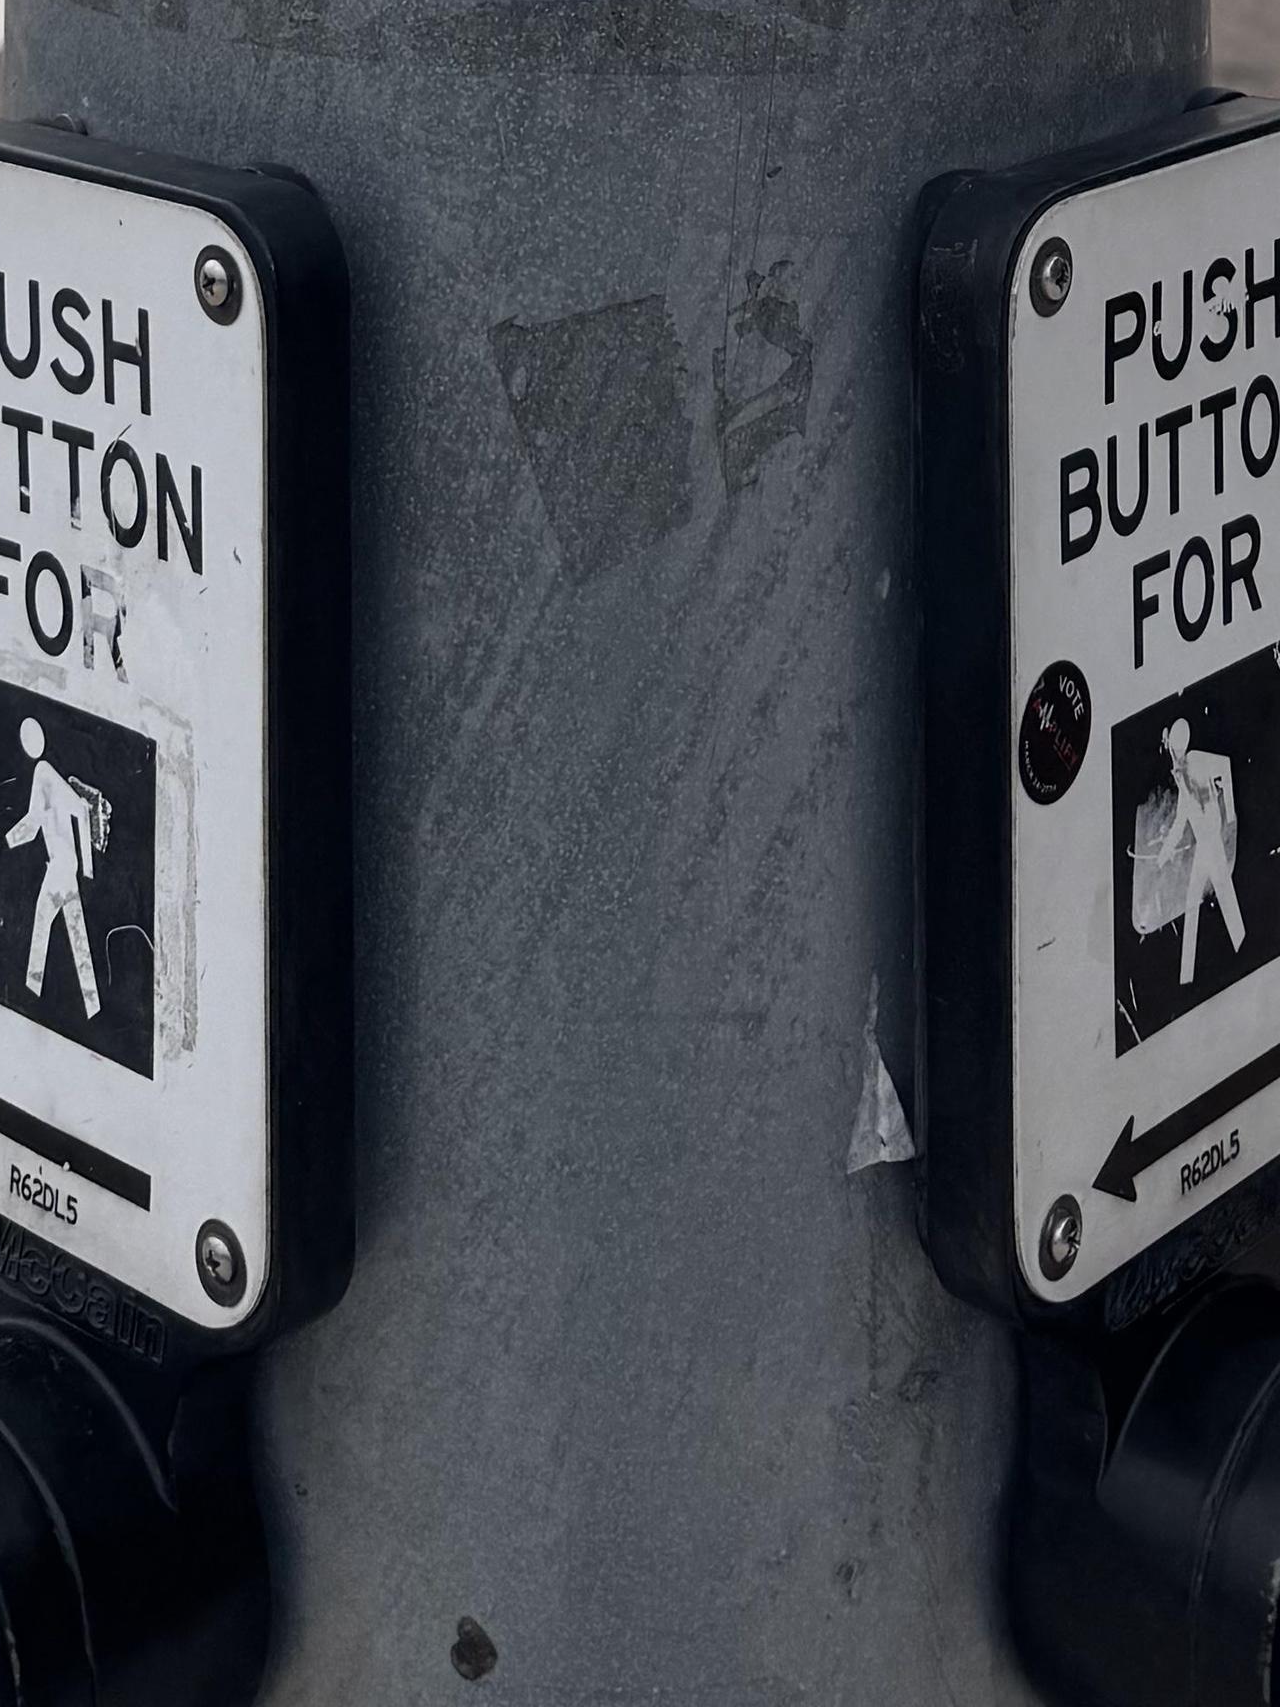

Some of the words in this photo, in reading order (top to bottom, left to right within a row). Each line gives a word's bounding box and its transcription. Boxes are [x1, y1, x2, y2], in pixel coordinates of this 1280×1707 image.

[1132, 514, 1262, 670] FOR
[1059, 674, 1084, 720] VOTE
[1181, 1128, 1241, 1196] R62DL5
[10, 1165, 77, 1225] R62DL5
